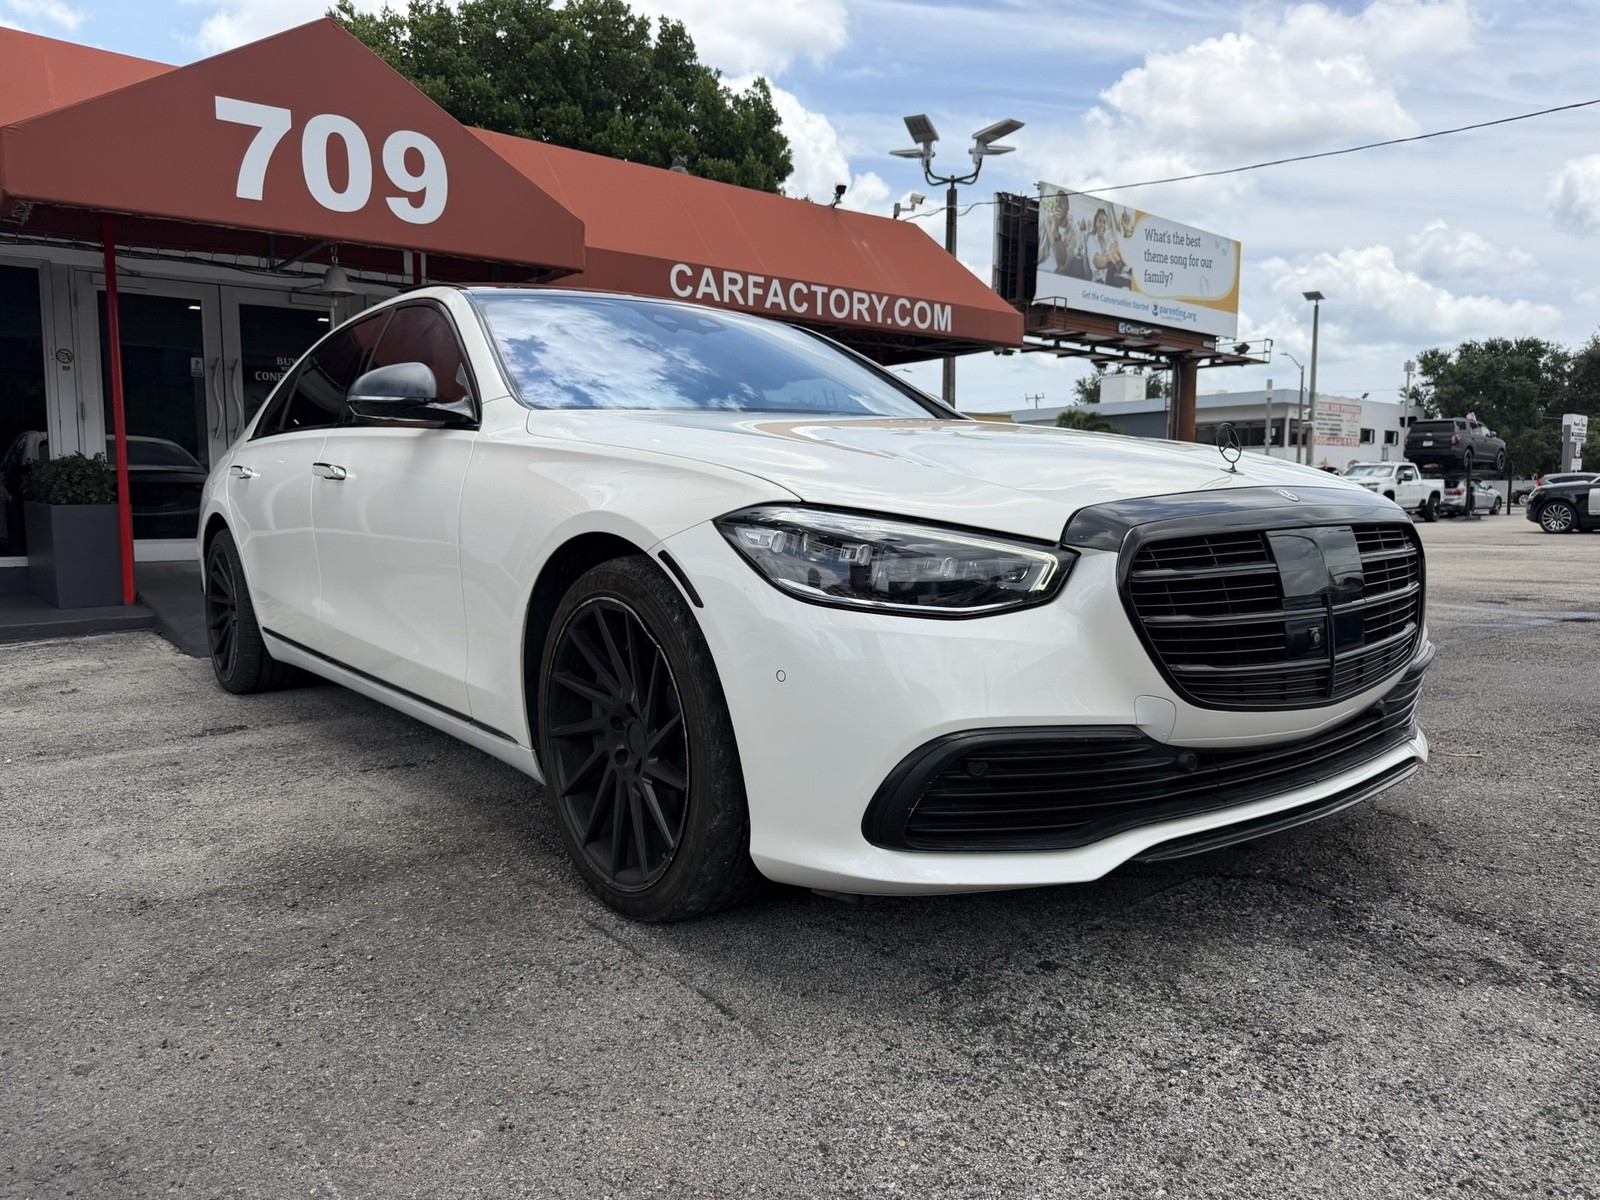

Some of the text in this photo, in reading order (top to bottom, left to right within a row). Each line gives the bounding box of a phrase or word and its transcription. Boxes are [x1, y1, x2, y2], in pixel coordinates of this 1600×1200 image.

[215, 95, 448, 225] 709
[1144, 228, 1201, 248] What's the best
[1144, 248, 1213, 269] theme song for our
[1144, 269, 1174, 287] family?
[669, 263, 952, 332] CARFACTORY.COM
[1082, 290, 1150, 311] Get the Conversation Started
[1160, 306, 1198, 322] parenting.org
